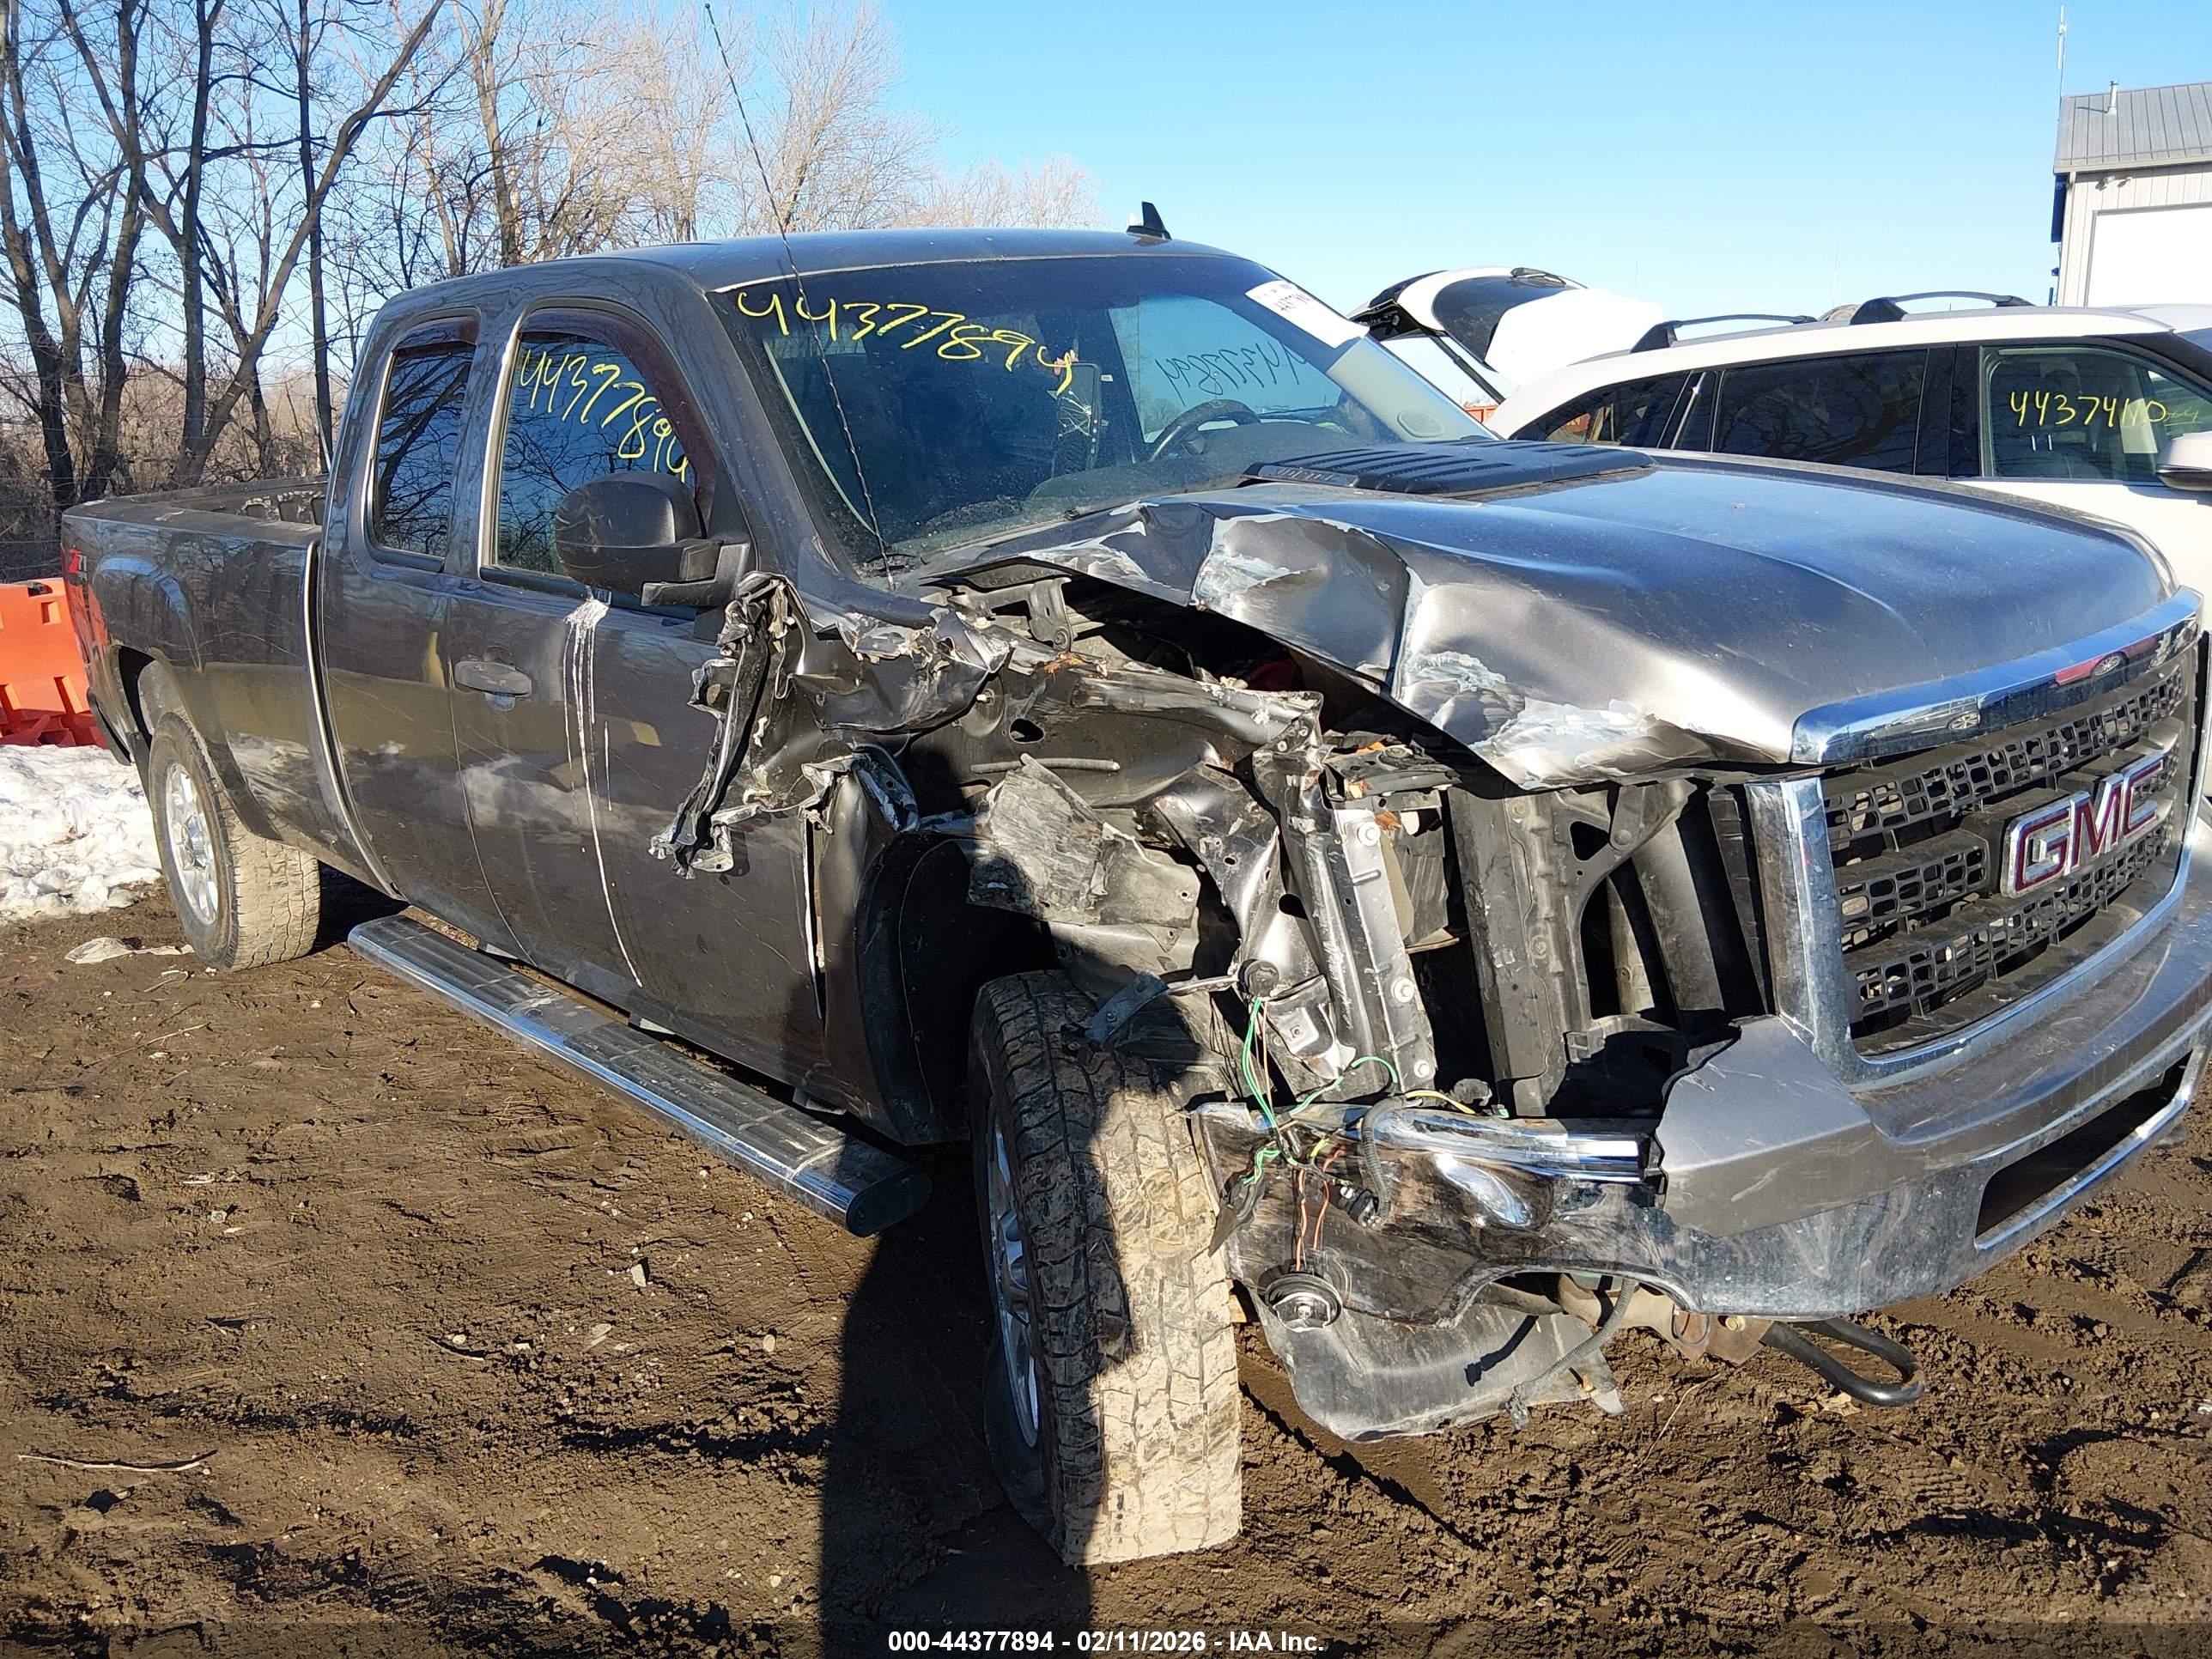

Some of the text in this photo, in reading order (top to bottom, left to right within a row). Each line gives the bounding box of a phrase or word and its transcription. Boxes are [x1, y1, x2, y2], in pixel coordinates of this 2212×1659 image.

[737, 291, 1073, 397] 44377894
[520, 349, 689, 483] 44377894
[2005, 753, 2166, 896] GMC
